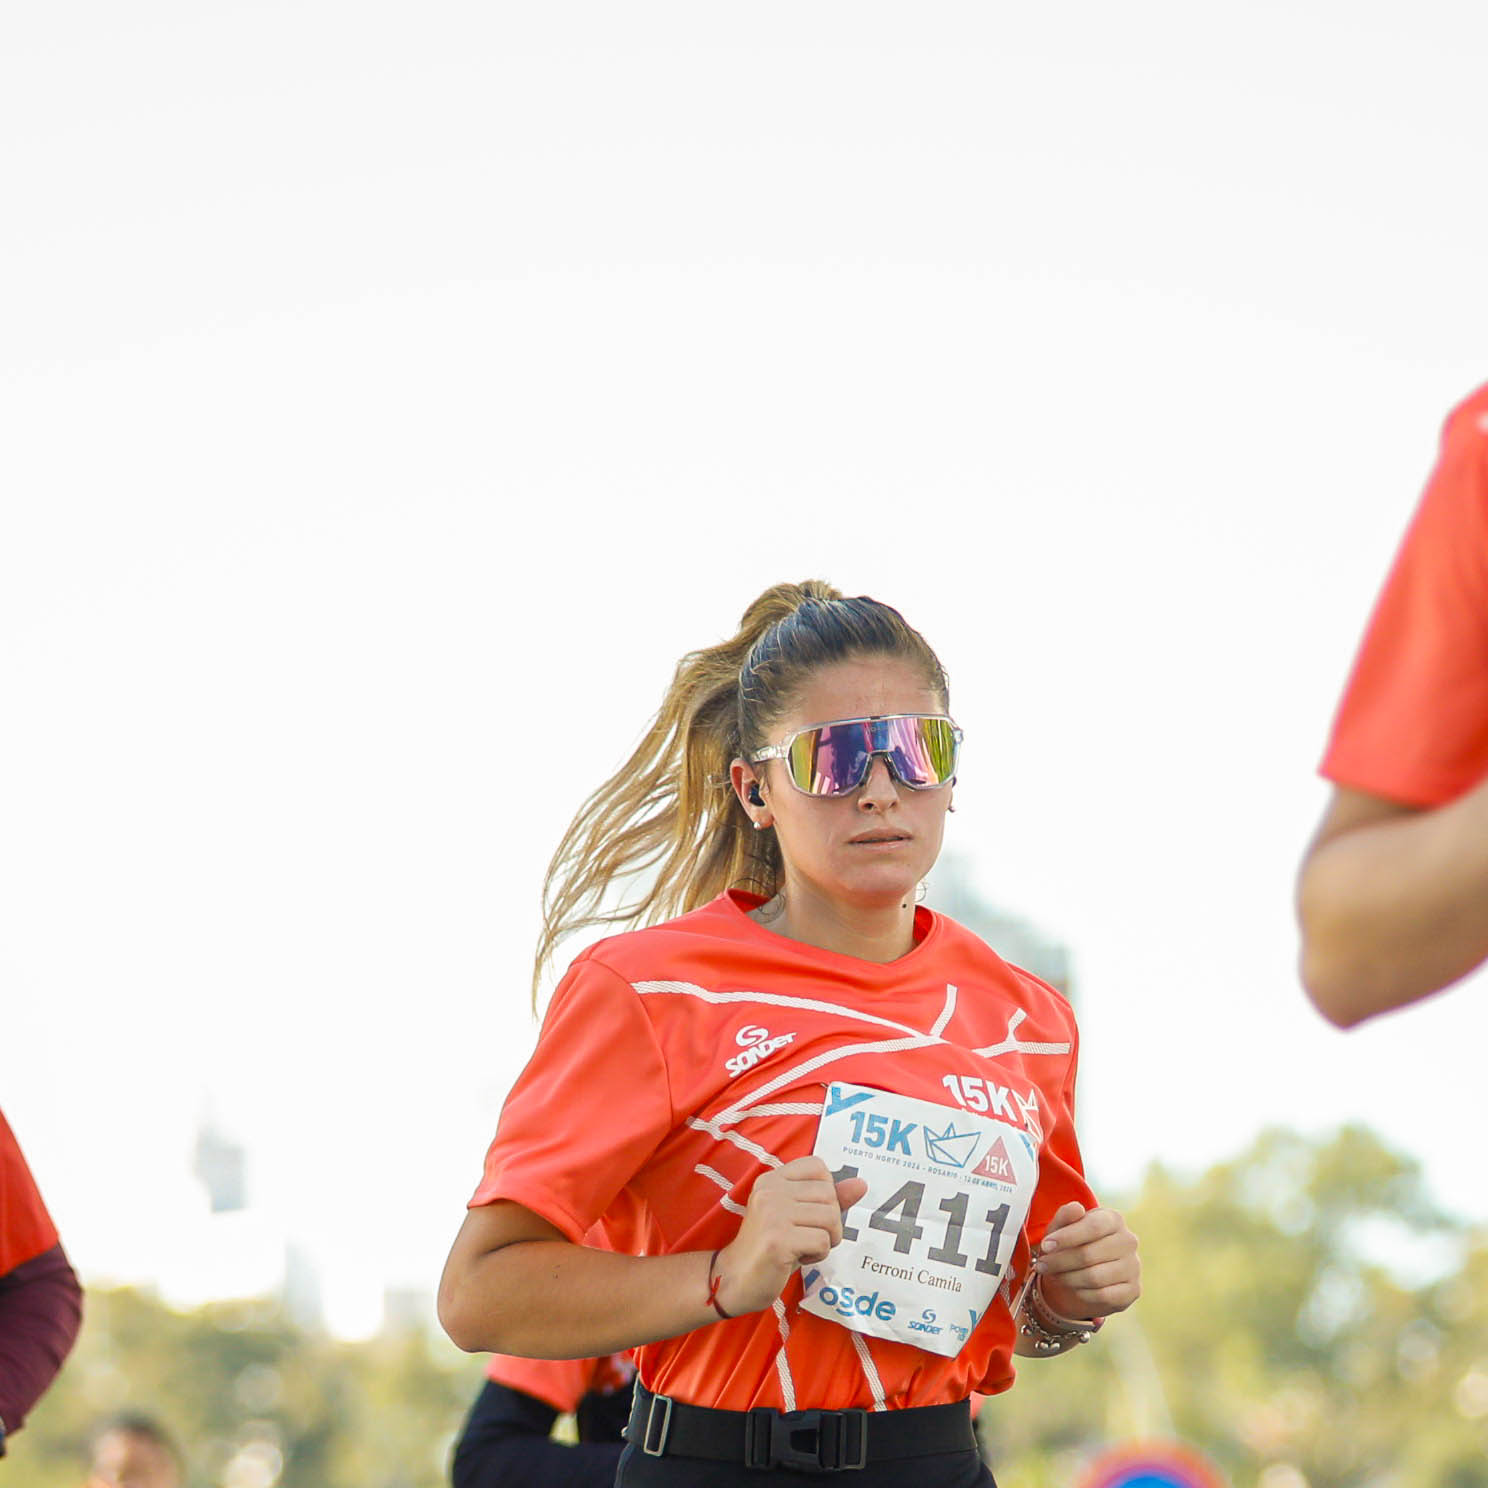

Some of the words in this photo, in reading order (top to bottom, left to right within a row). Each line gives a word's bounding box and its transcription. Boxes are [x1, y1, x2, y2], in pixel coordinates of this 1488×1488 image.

[941, 1073, 1019, 1123] 15K
[849, 1110, 918, 1157] 15K
[842, 1146, 874, 1160] PUERTO
[876, 1154, 900, 1166] NORTE
[928, 1166, 958, 1180] ROSARIO
[984, 1154, 1009, 1177] 15K
[860, 1255, 914, 1281] Ferroni
[917, 1269, 963, 1293] Camila
[818, 1286, 897, 1322] osde
